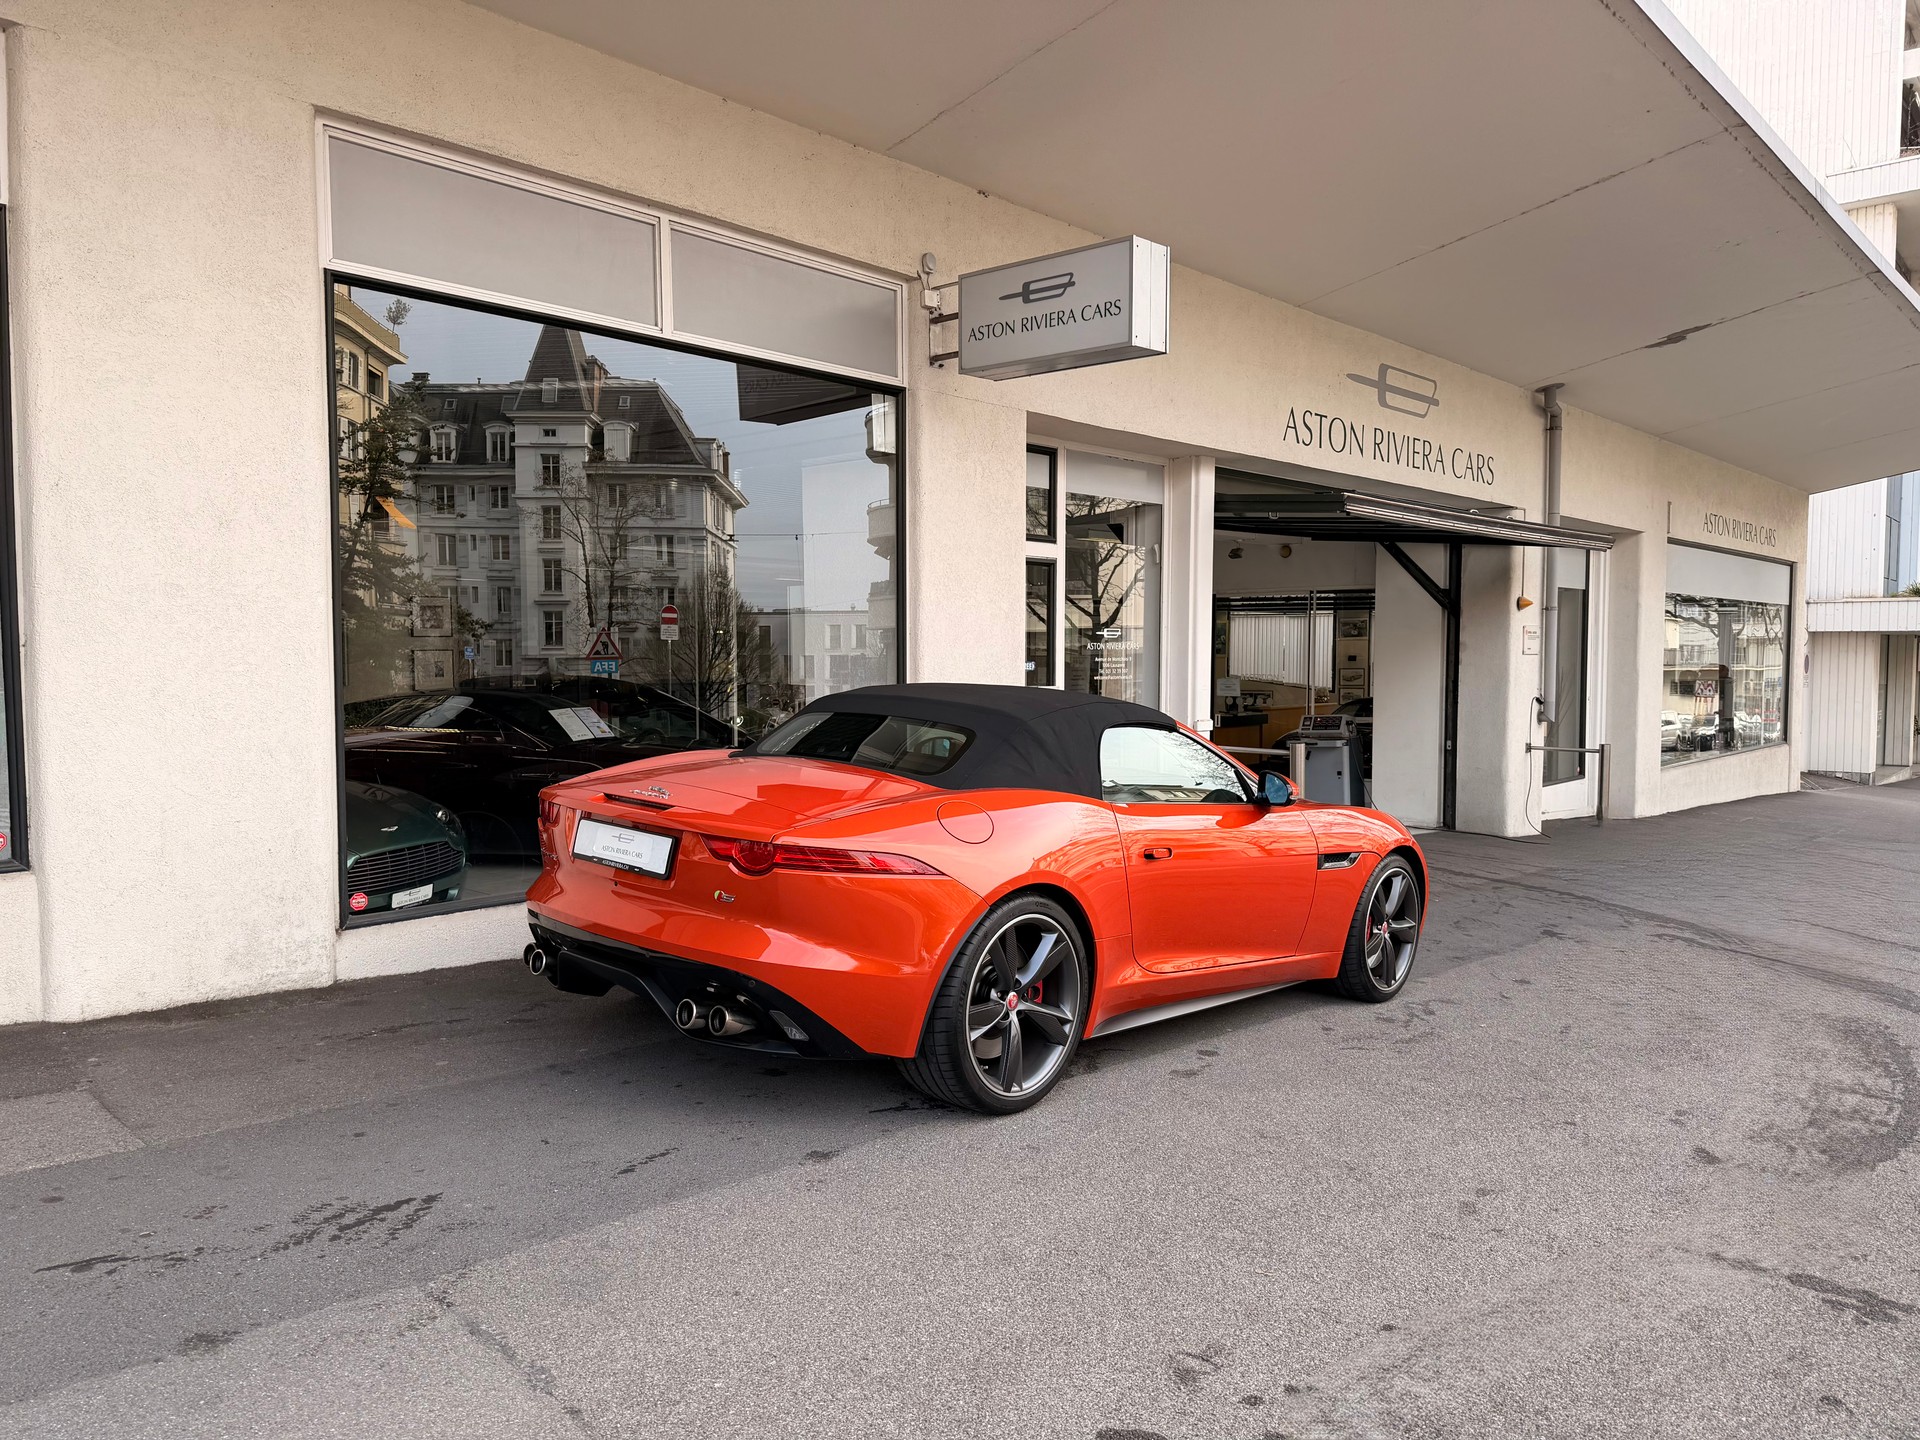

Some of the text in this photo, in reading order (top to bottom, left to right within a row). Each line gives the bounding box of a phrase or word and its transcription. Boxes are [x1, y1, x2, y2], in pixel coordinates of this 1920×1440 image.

[968, 298, 1122, 343] ASTON RIVIERA CARS
[1283, 407, 1495, 486] ASTON RIVIERA CARS
[1703, 512, 1777, 547] ASTON RIVIERA CARS
[1087, 642, 1105, 650] ASTON
[1106, 642, 1125, 650] RIVIERA
[601, 845, 644, 859] ASTON RIVIERA CARS
